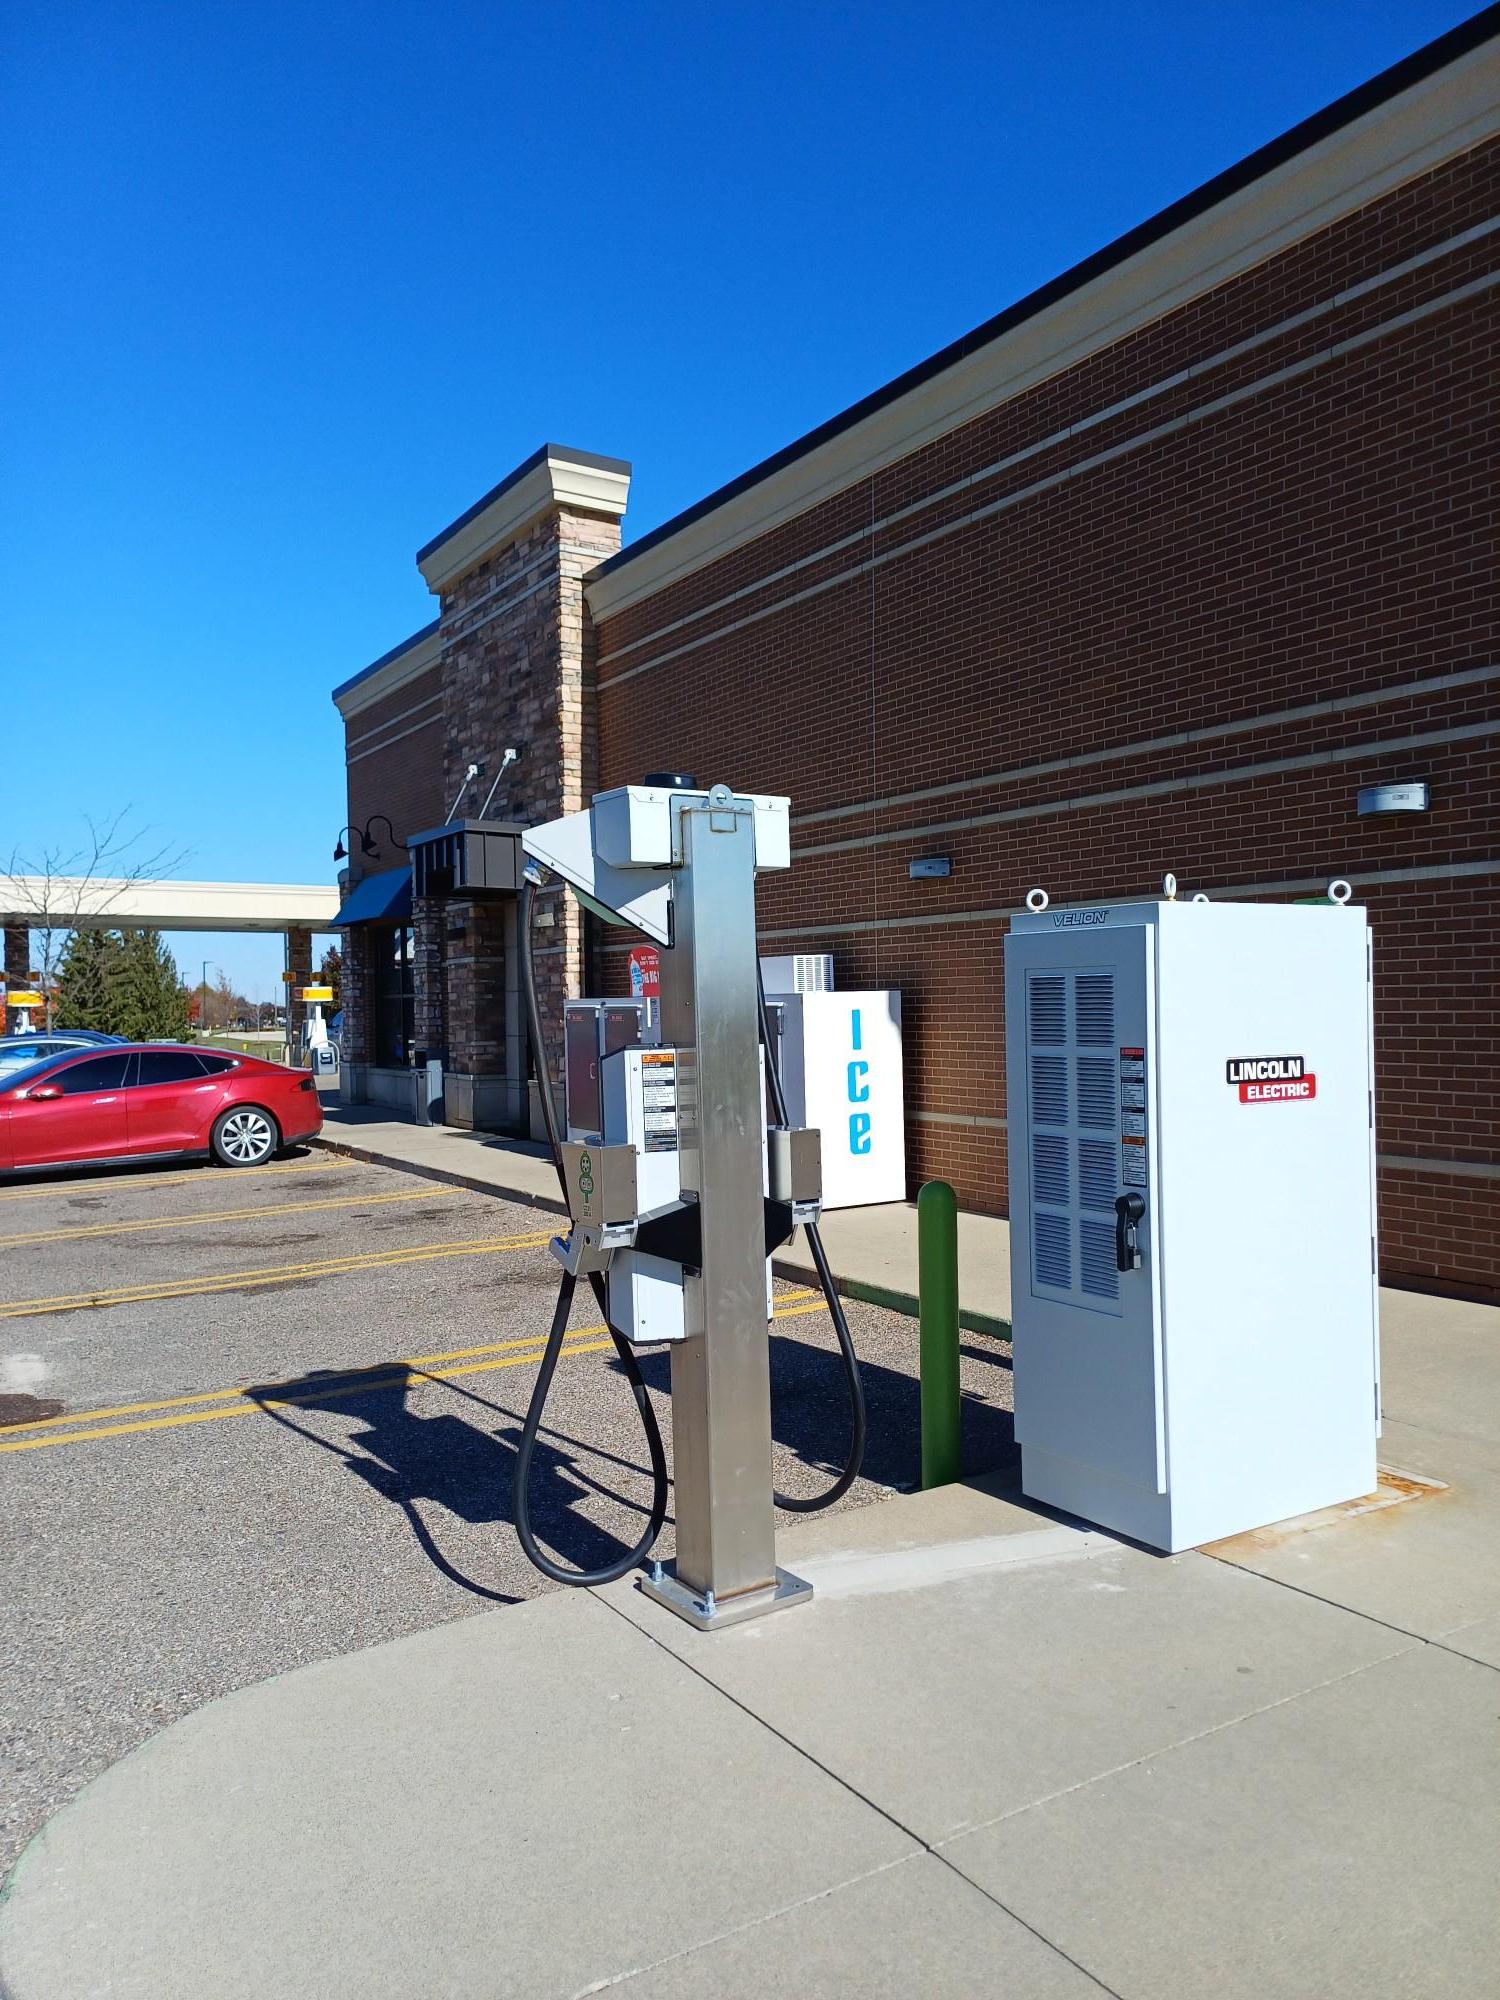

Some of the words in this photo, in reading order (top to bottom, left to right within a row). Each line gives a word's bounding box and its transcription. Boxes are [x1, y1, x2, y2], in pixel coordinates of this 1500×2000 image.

[1053, 911, 1106, 927] VELION
[1229, 1059, 1301, 1081] LINCOLN
[1246, 1082, 1310, 1100] ELECTRIC
